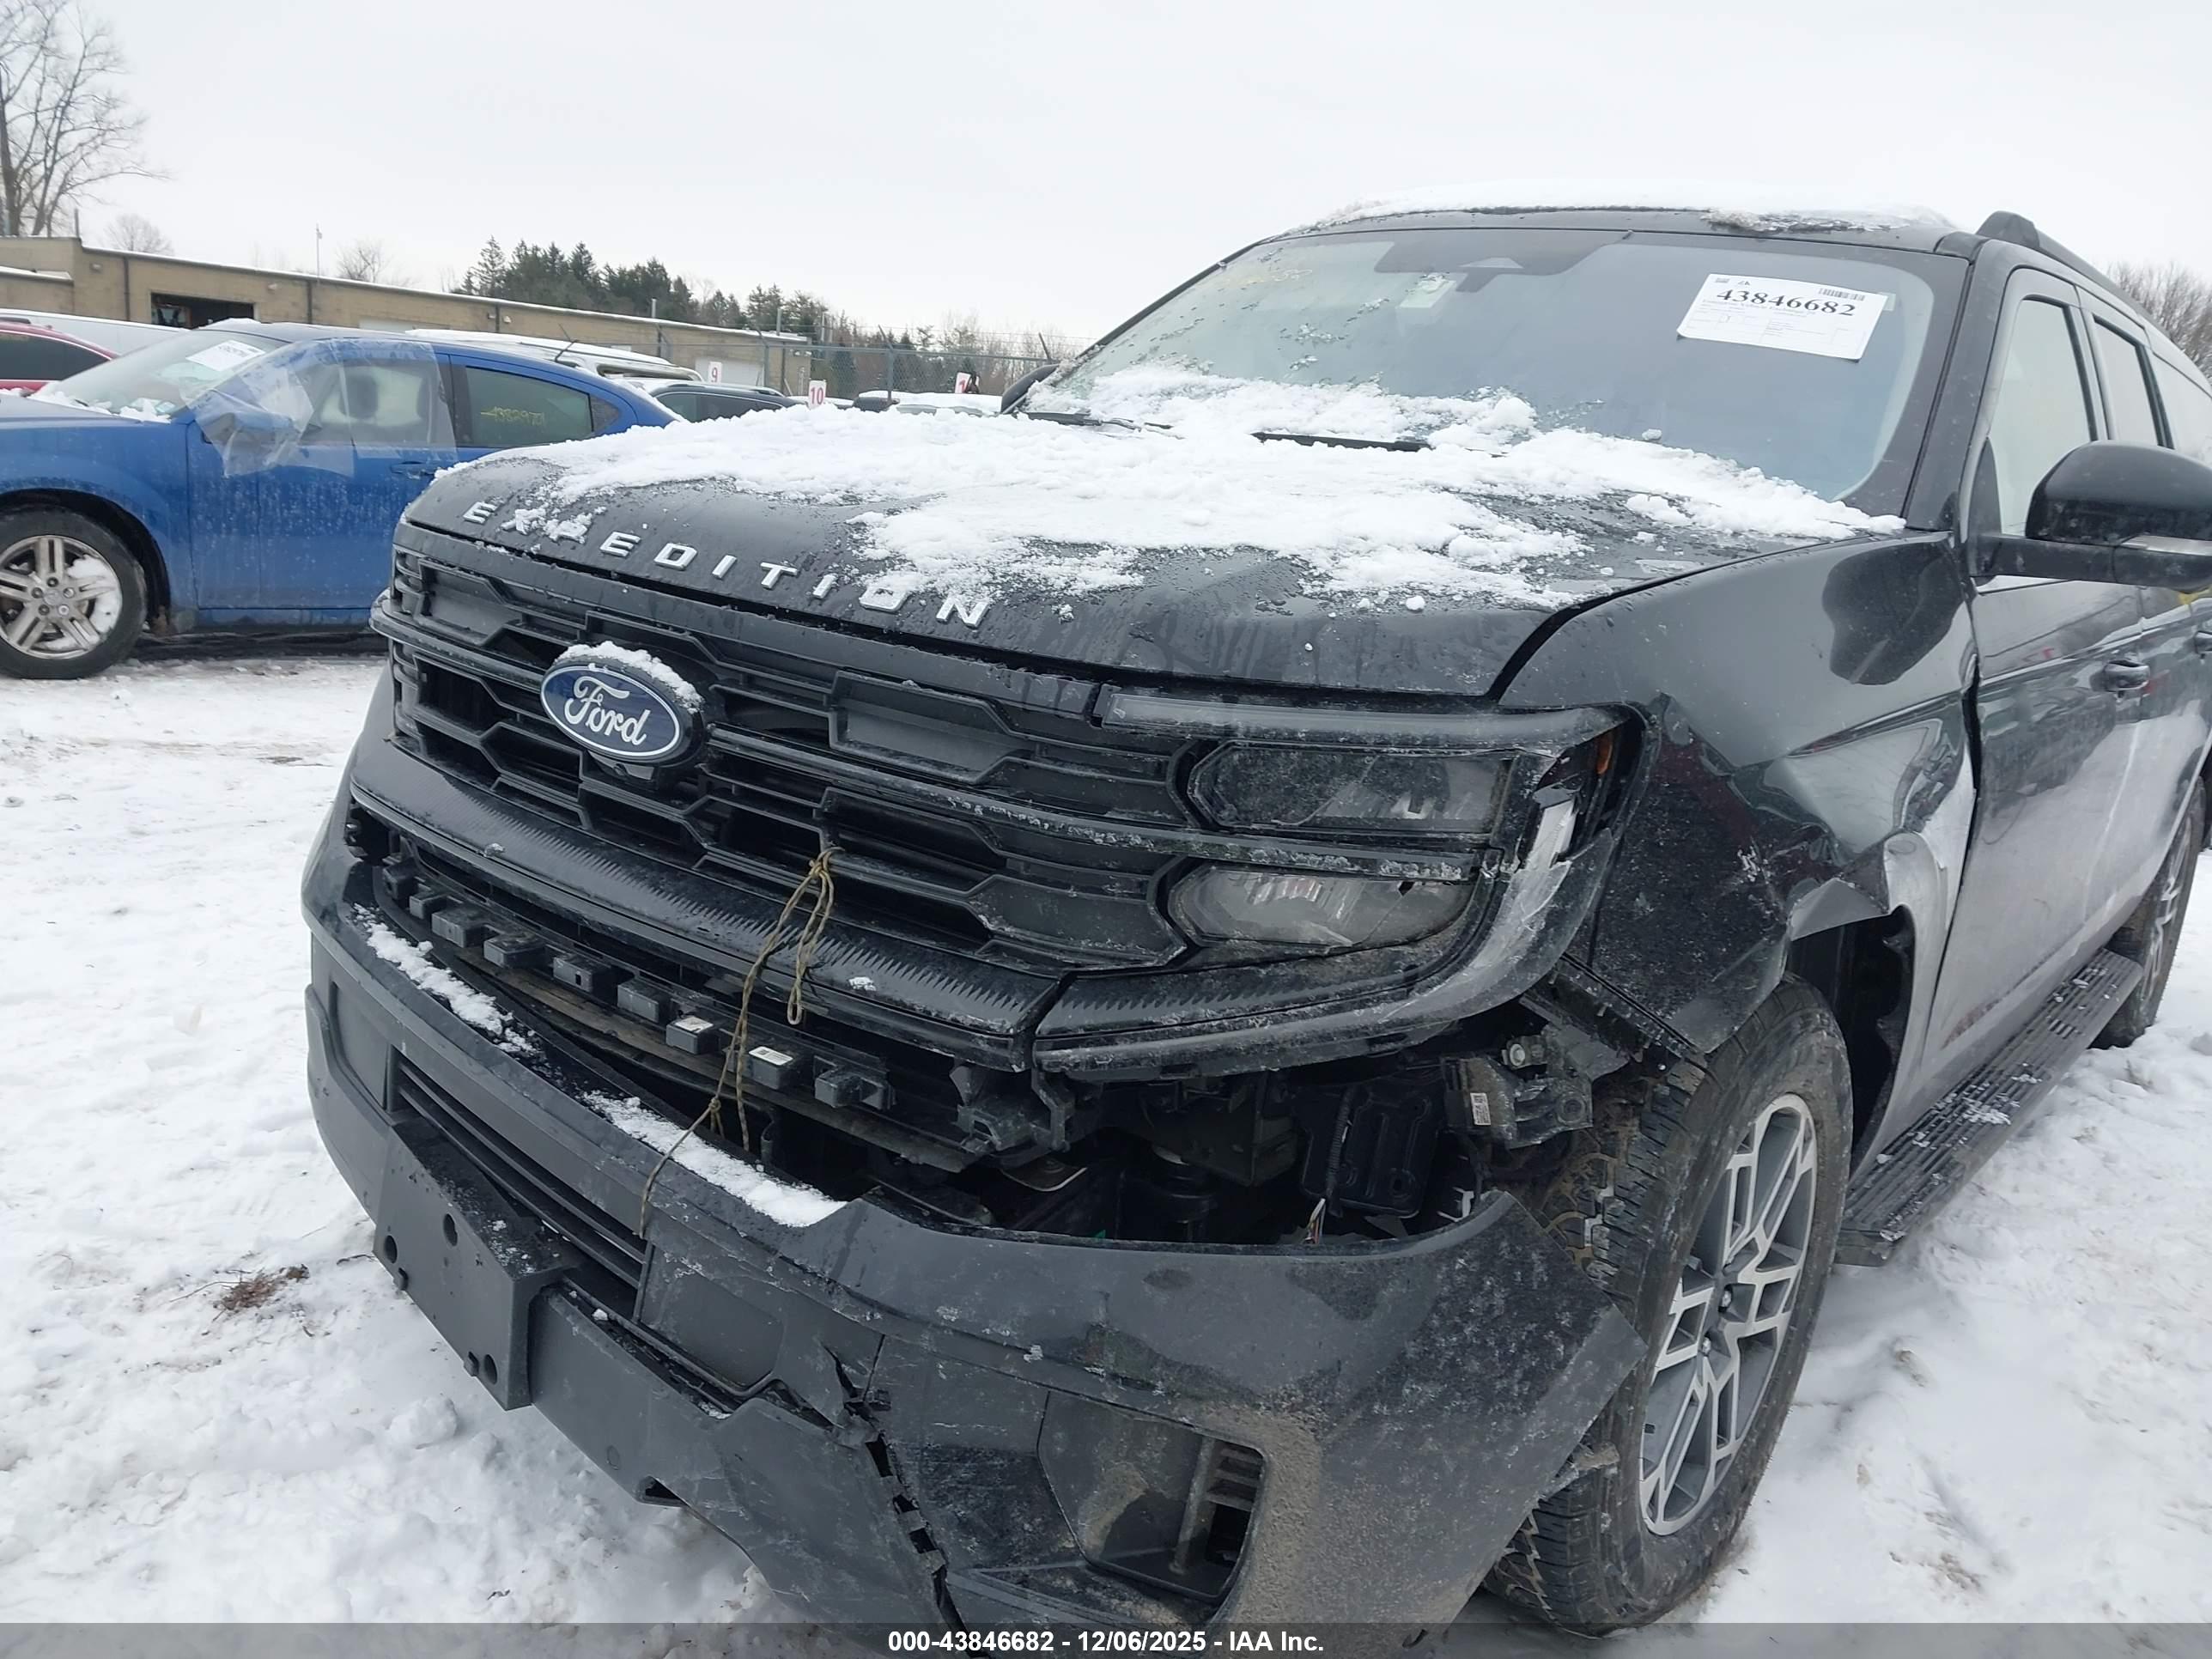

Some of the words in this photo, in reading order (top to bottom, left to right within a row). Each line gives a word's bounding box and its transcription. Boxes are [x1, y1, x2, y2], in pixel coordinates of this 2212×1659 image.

[1717, 289, 1856, 316] 43846682
[711, 366, 719, 383] 9
[811, 386, 824, 405] 10
[564, 676, 651, 745] Ford
